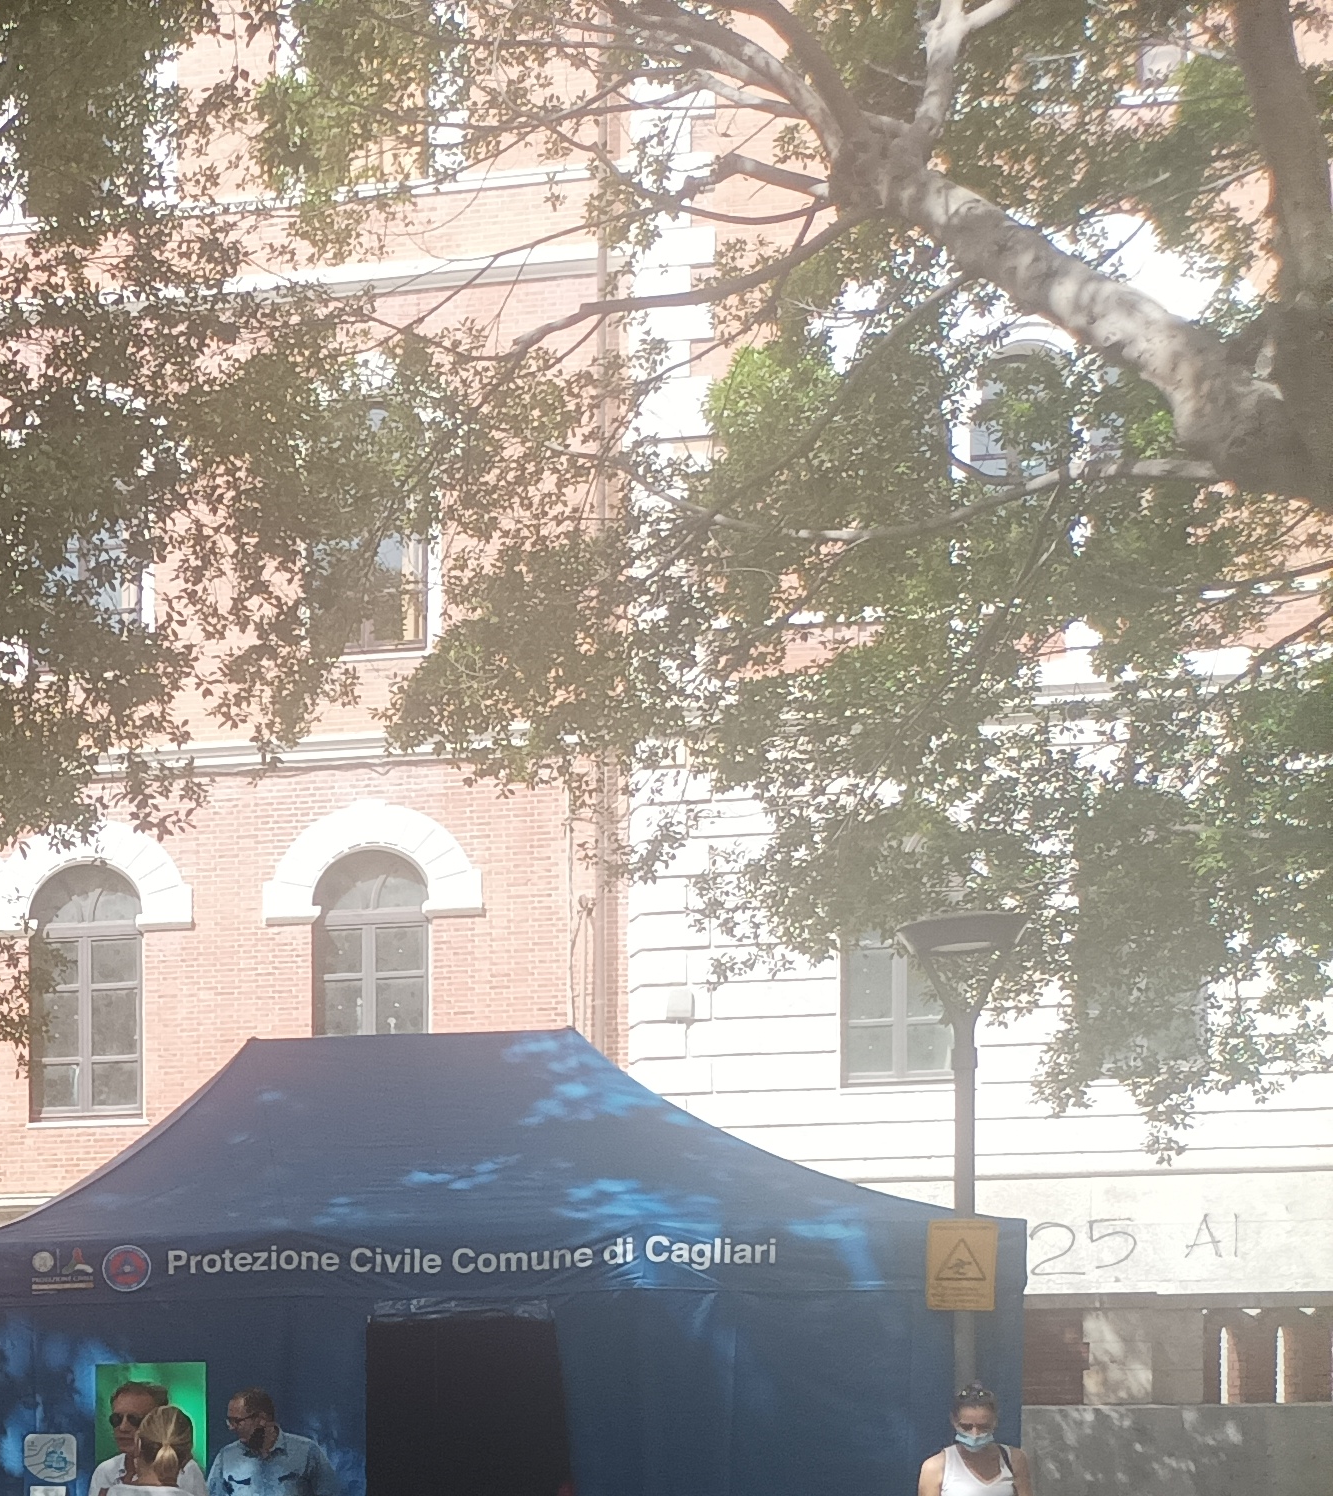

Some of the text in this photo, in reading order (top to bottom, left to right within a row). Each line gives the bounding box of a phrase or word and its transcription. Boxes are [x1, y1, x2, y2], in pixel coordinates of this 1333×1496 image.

[167, 1246, 340, 1274] Protezione
[350, 1247, 442, 1273] Civile
[452, 1247, 593, 1273] Comune
[603, 1236, 634, 1262] di
[645, 1235, 776, 1270] Cagliari
[1029, 1217, 1137, 1276] 25
